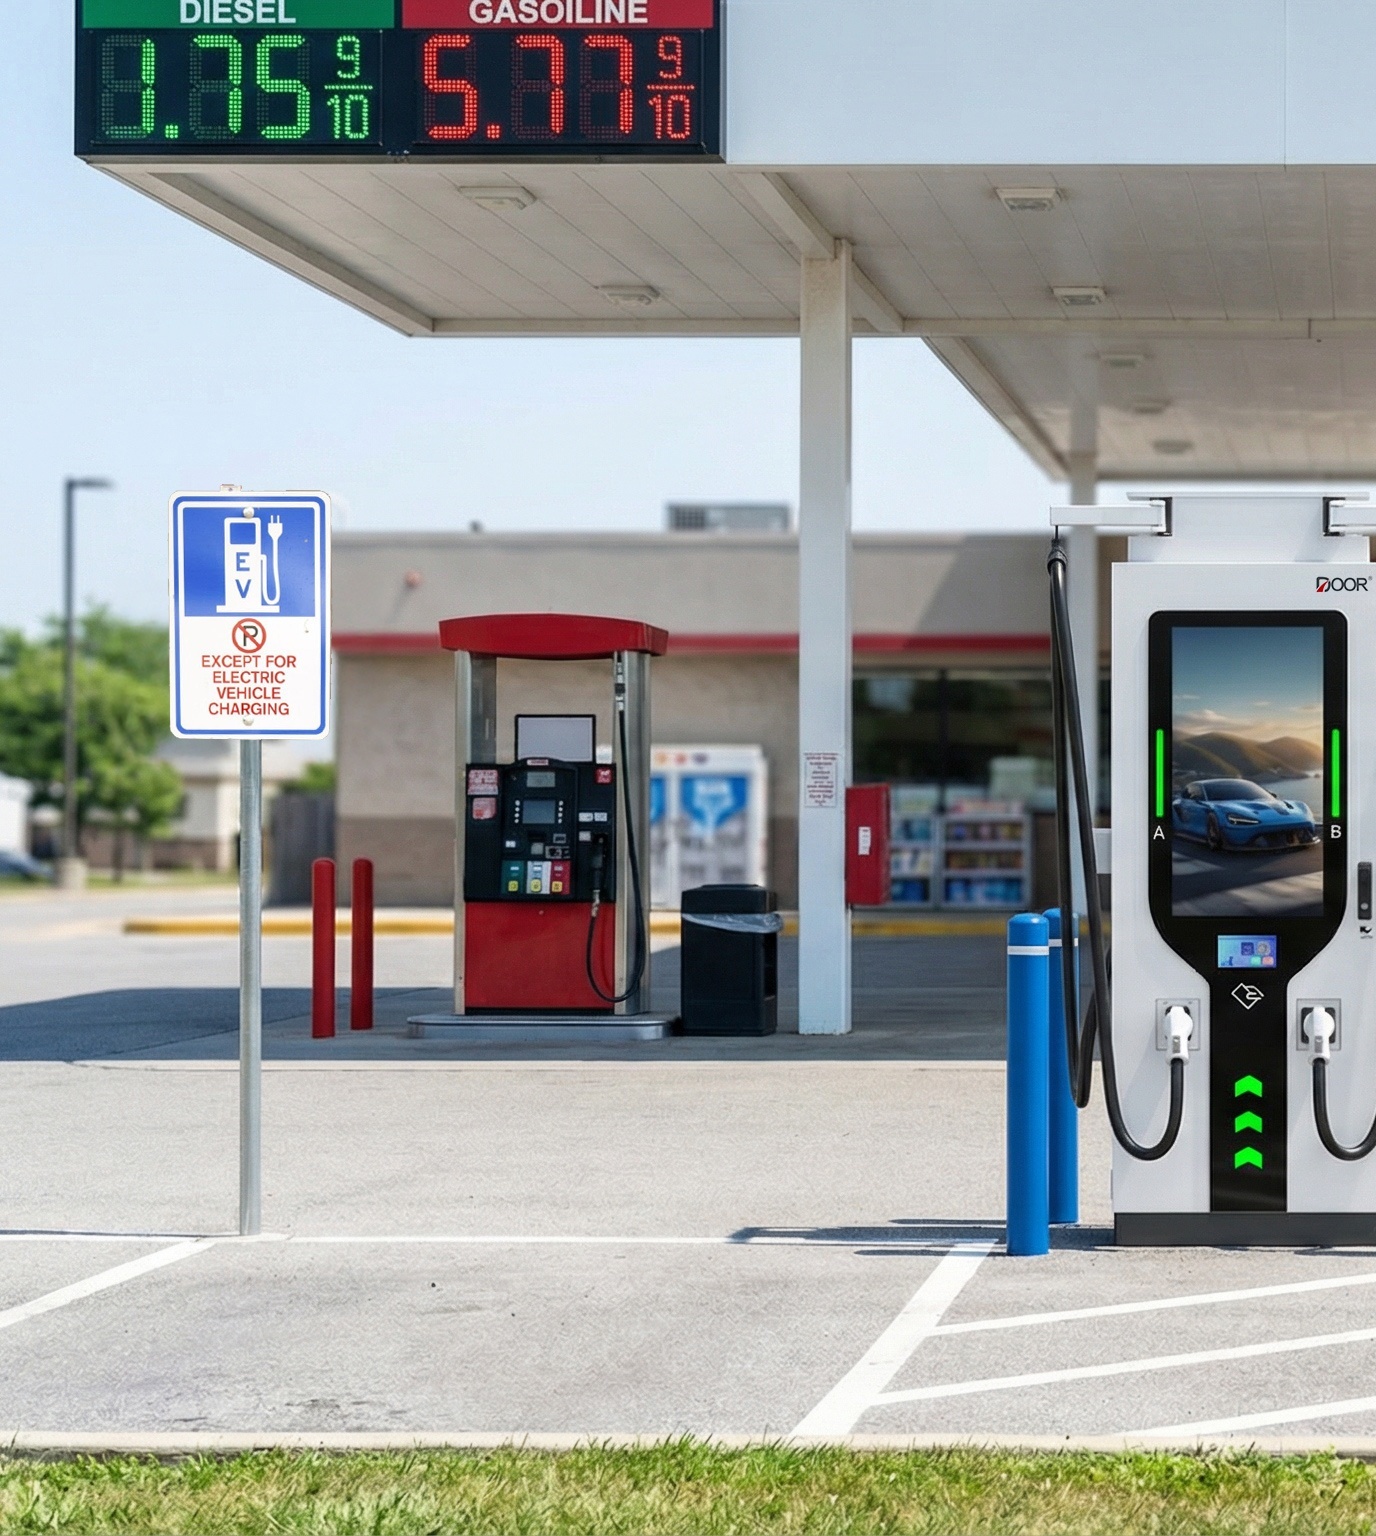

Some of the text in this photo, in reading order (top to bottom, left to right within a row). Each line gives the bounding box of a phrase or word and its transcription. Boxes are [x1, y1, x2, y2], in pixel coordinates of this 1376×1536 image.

[179, 0, 296, 24] DIESEL
[468, 0, 649, 24] GASOILINE
[141, 34, 311, 139] 1.75
[424, 34, 634, 139] 5.77
[201, 655, 297, 669] EXCEPT FOR
[212, 671, 286, 685] ELECTRIC
[216, 687, 281, 700] VEHICLE
[208, 702, 290, 716] CHARGING
[1153, 825, 1165, 840] A
[1330, 825, 1342, 839] B
